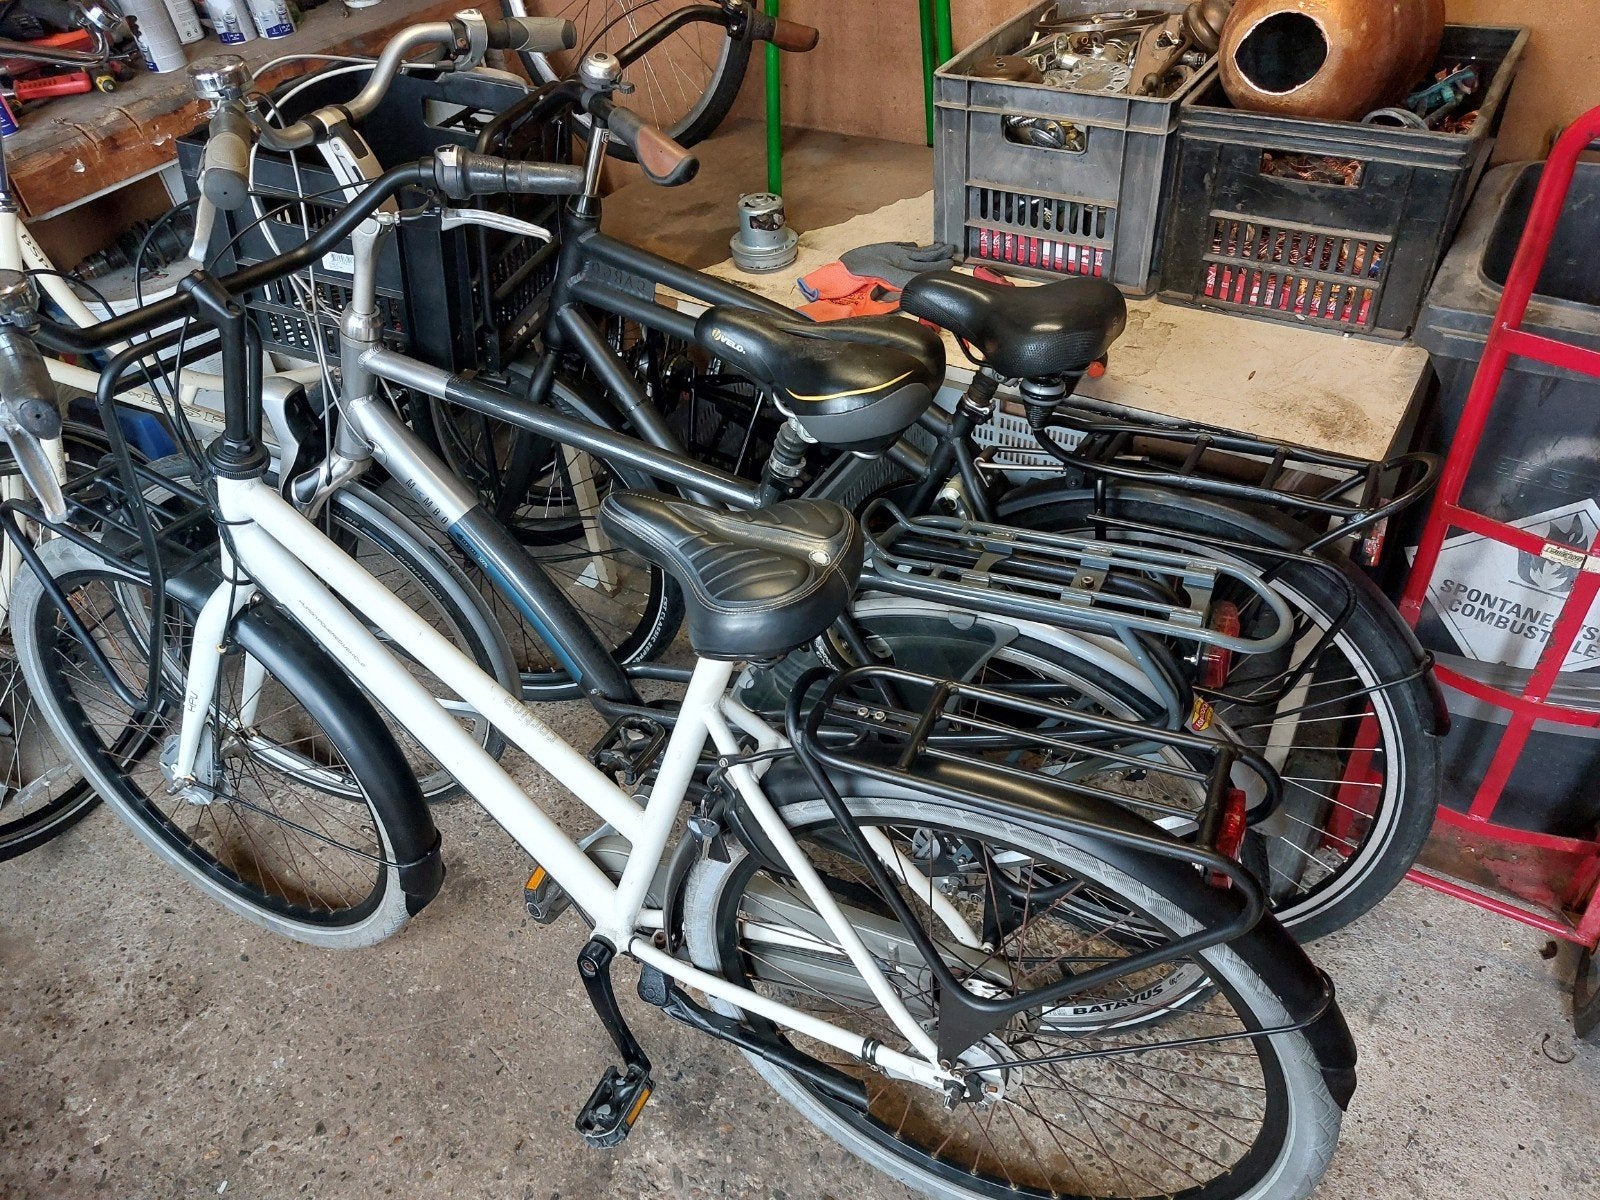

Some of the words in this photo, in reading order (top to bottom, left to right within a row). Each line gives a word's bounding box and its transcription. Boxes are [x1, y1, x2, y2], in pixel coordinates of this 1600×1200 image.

[405, 478, 449, 525] MAMBO
[396, 553, 443, 600] MARATHON
[650, 611, 666, 643] CLASSIC
[1072, 984, 1163, 1015] BATAVUS
